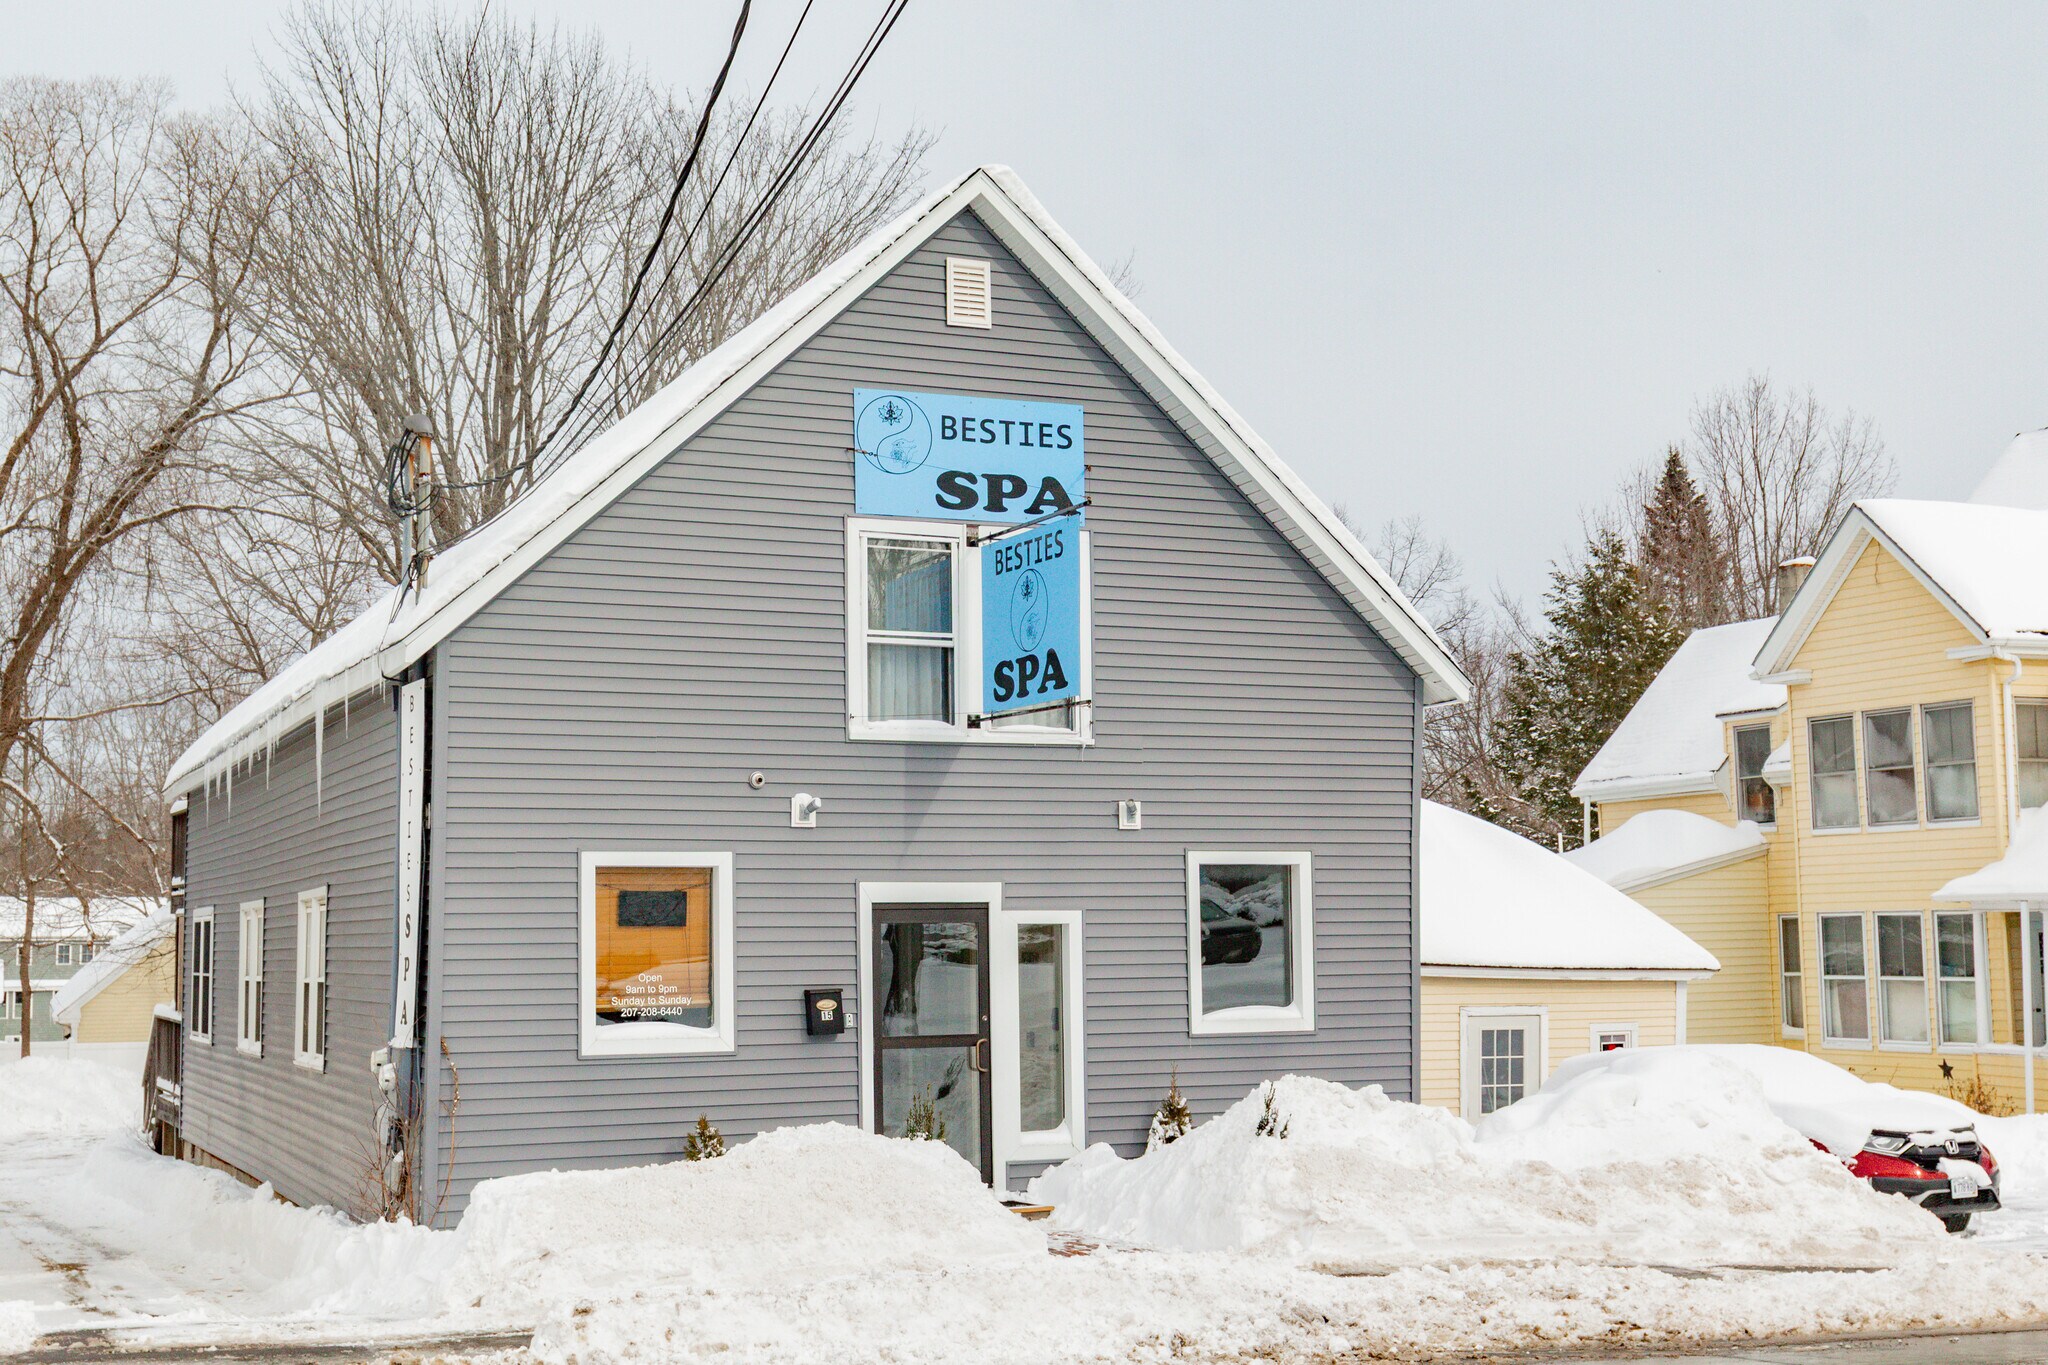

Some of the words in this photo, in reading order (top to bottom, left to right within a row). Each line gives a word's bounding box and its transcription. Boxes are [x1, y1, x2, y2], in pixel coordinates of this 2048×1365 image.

[941, 415, 1073, 450] BESTIES
[935, 470, 1081, 516] SPA
[995, 529, 1064, 576] BESTIES
[993, 648, 1068, 702] SPA
[405, 694, 415, 902] BESTIES
[400, 914, 411, 1025] SPA
[638, 973, 662, 983] Open
[611, 996, 645, 1007] Sunday
[647, 996, 656, 1005] to
[658, 995, 692, 1005] Sunday
[625, 985, 645, 994] 9am
[647, 985, 656, 993] to
[658, 984, 678, 994] 9pm
[620, 1006, 683, 1017] 207-208-6440
[822, 1012, 832, 1020] 15
